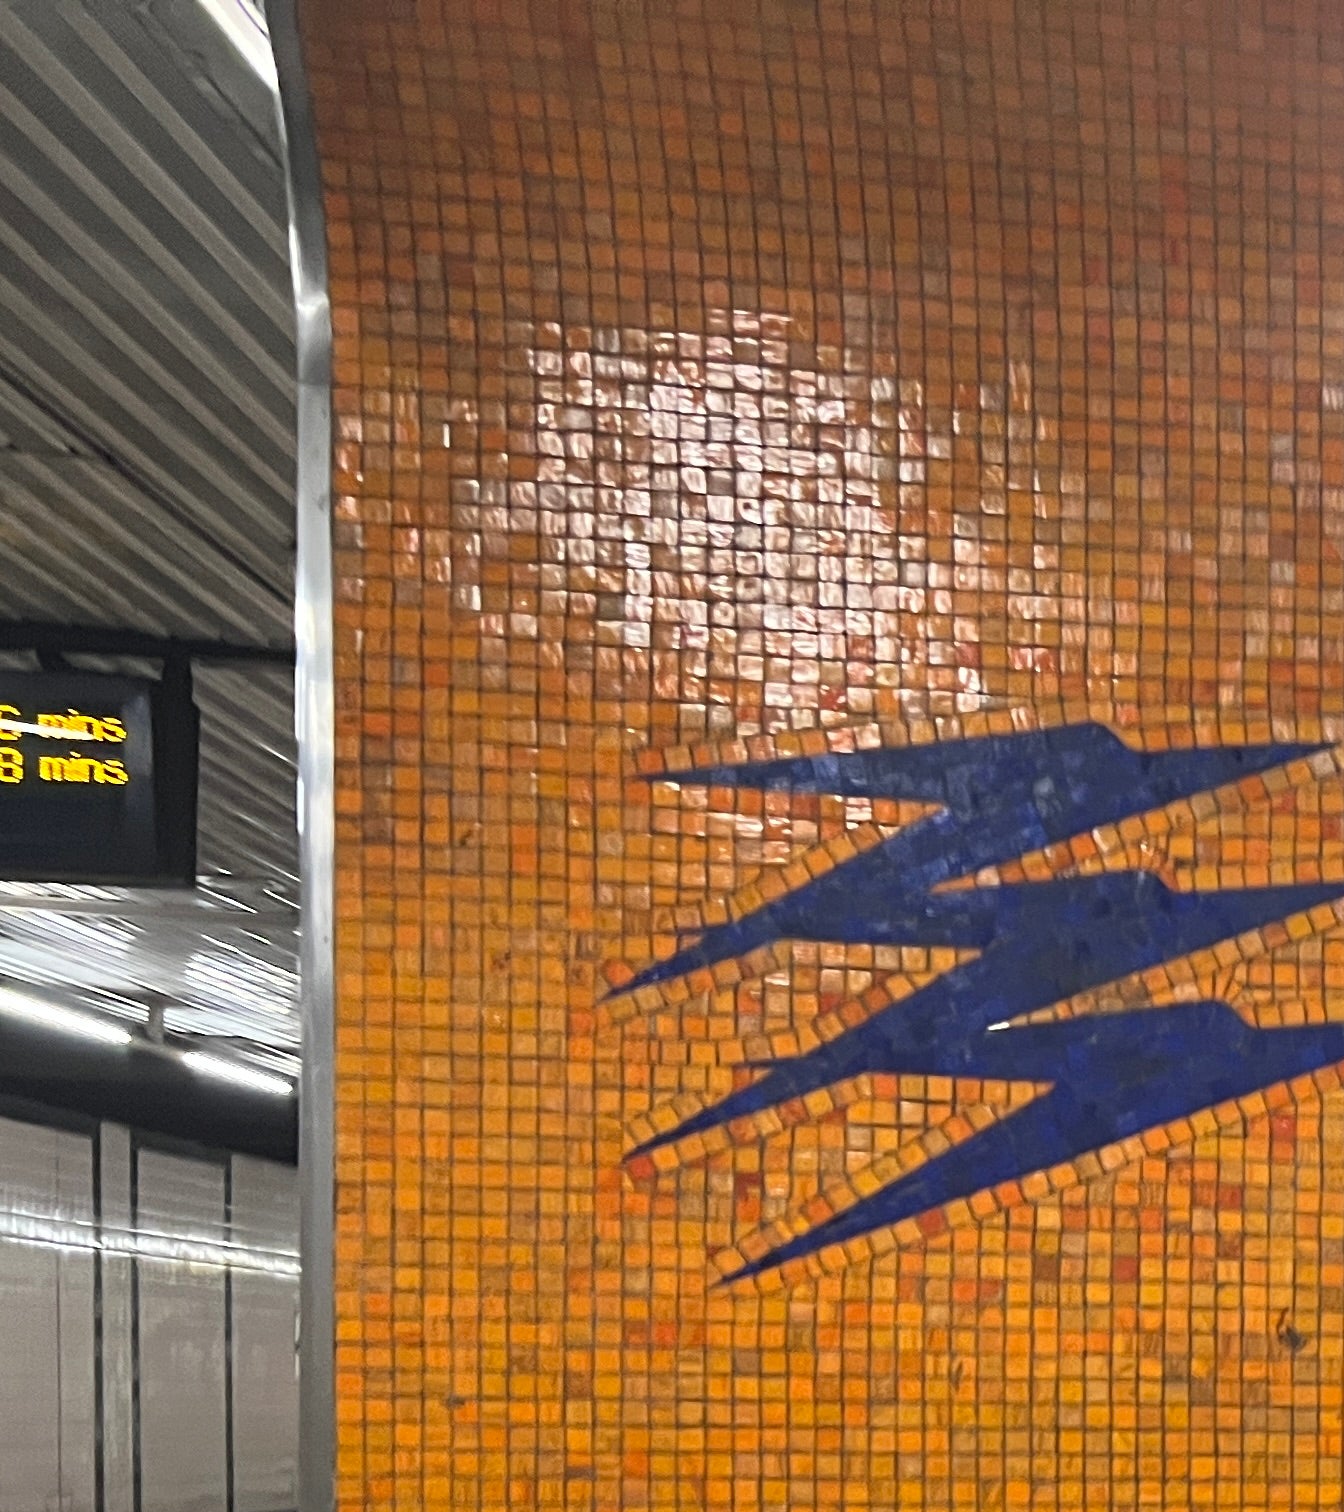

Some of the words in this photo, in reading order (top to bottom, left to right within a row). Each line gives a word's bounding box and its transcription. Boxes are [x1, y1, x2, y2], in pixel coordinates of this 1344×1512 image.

[37, 708, 127, 743] mins
[0, 746, 24, 784] 8
[39, 751, 129, 785] mins
